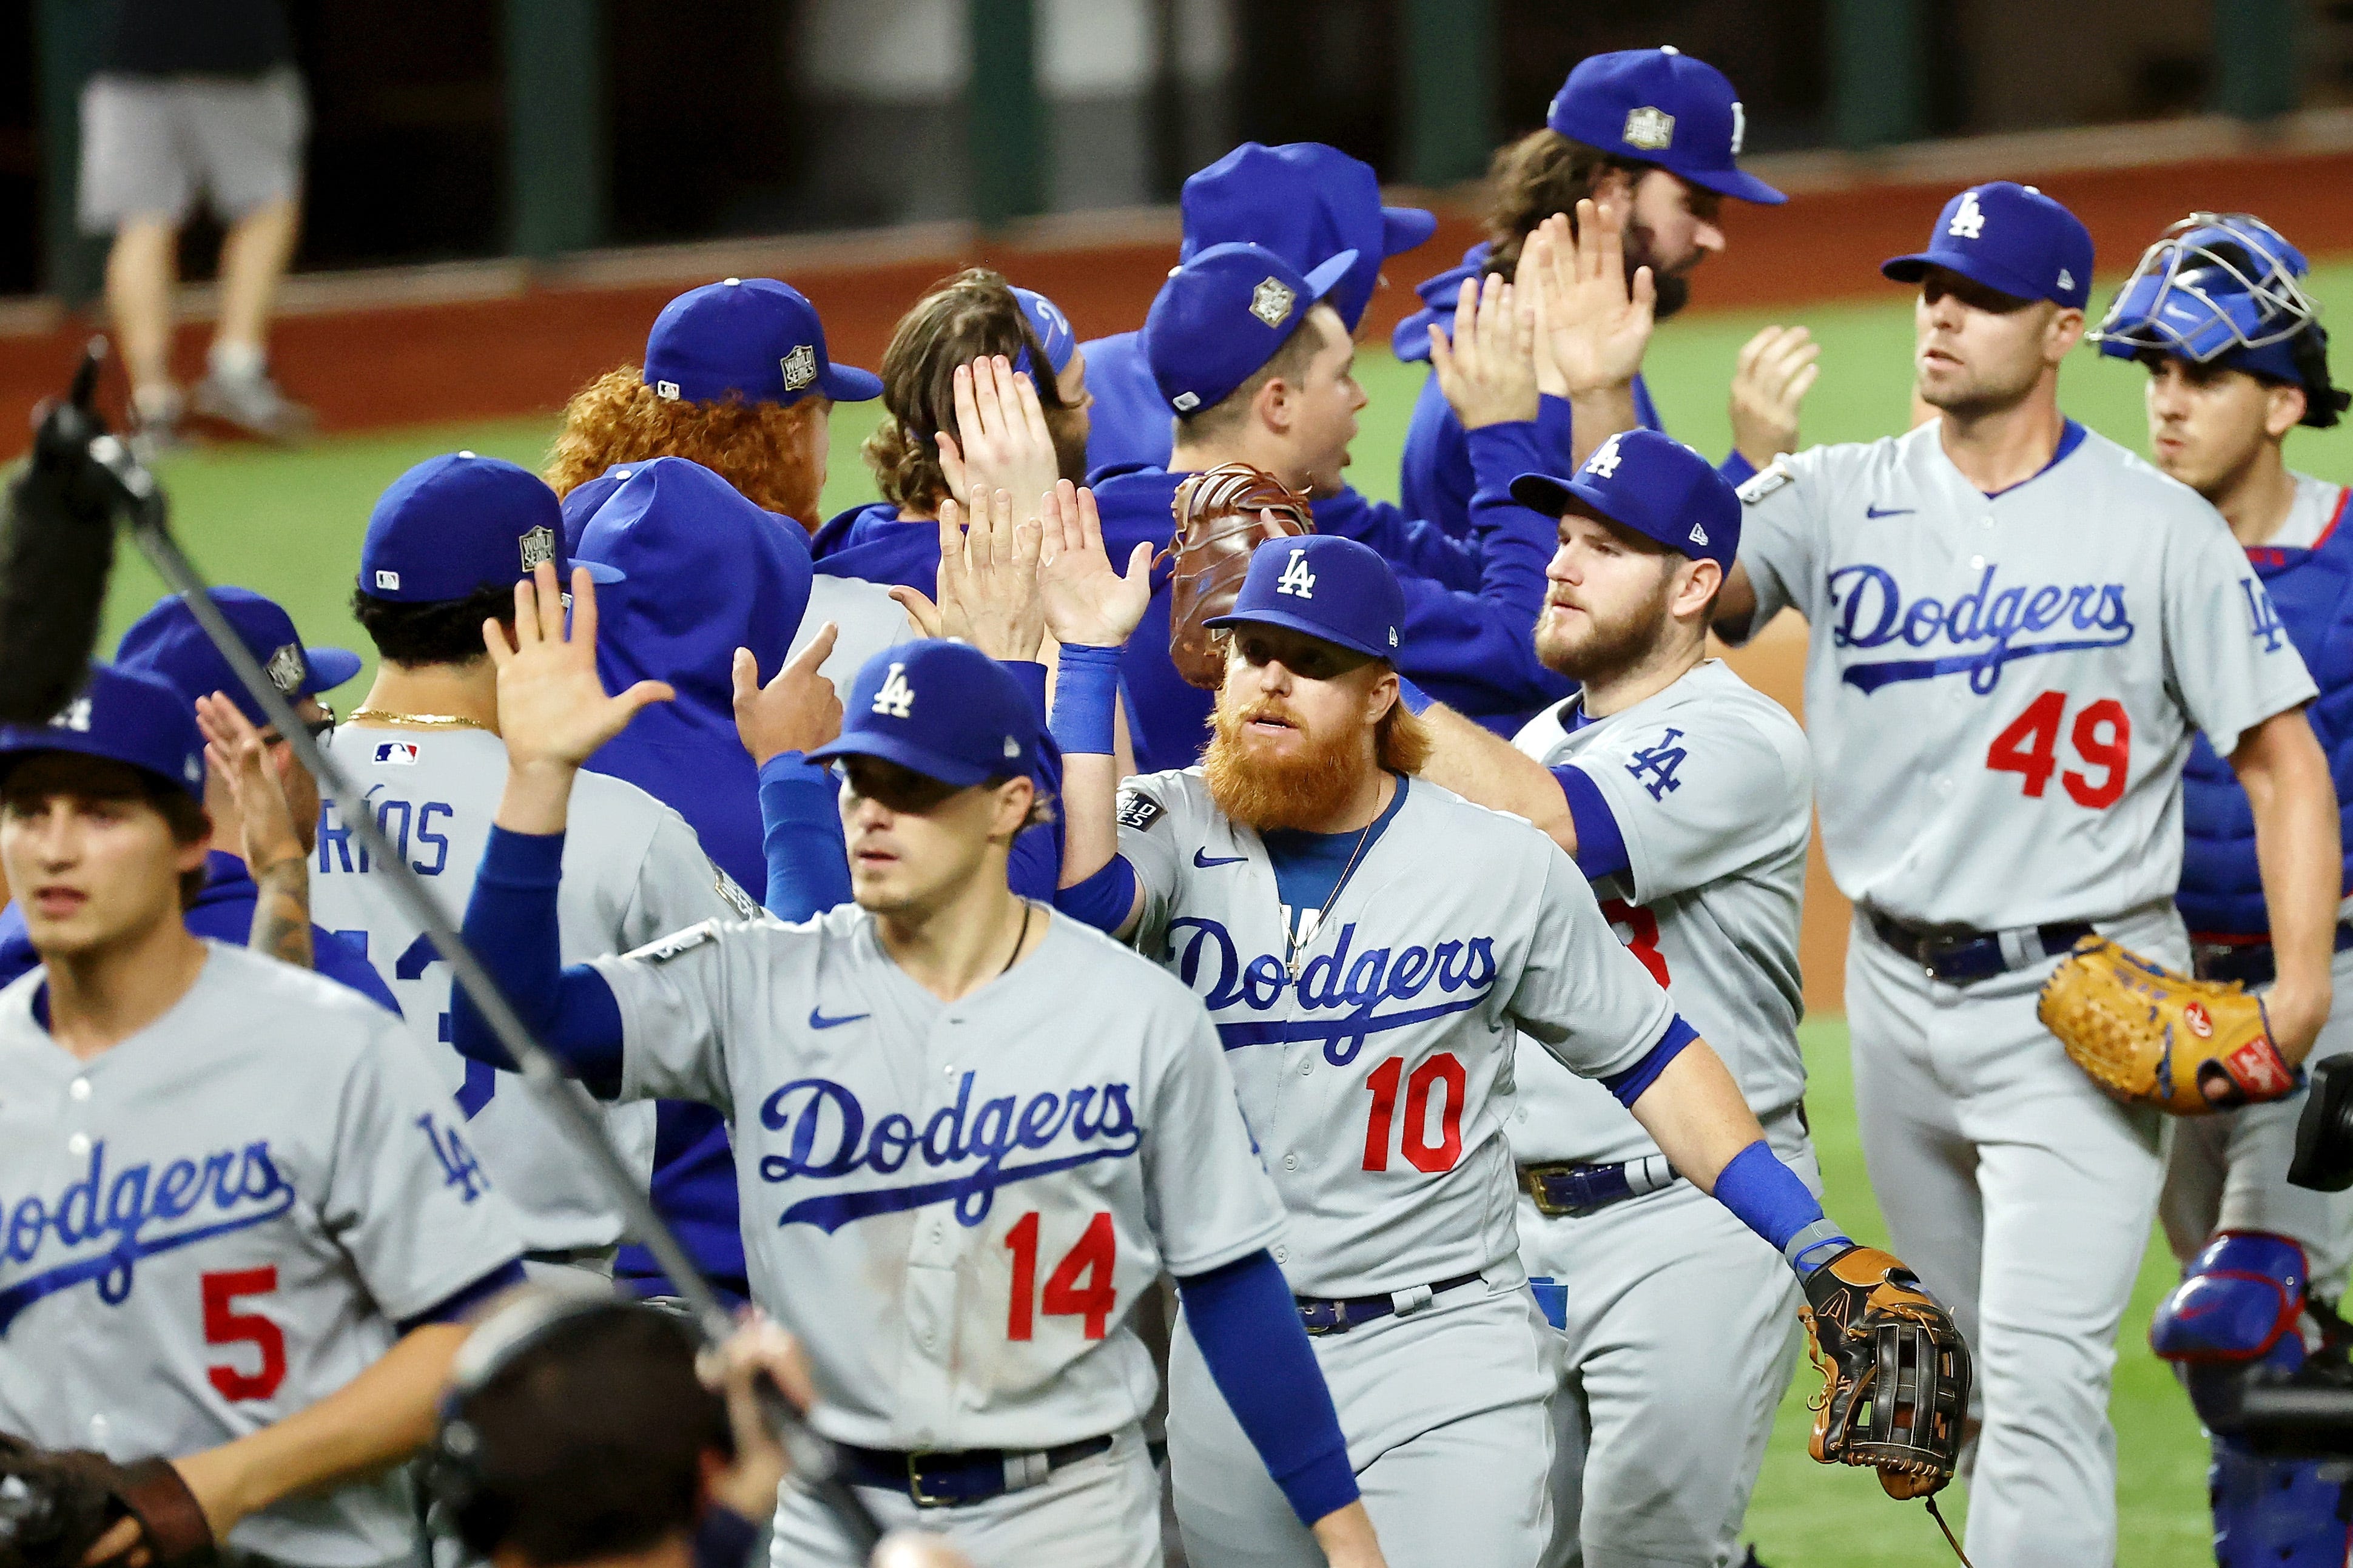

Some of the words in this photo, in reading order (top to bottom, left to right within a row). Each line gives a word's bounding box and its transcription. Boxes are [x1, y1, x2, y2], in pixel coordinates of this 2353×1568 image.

[1948, 191, 1985, 239] LA
[1585, 432, 1623, 479] LA
[1276, 548, 1316, 599] LA
[1827, 564, 2134, 695] Dodgers
[872, 662, 915, 719] LA
[1985, 690, 2132, 810] 49
[1624, 727, 1686, 803] LA
[1165, 916, 1497, 1066] Dodgers
[759, 1070, 1141, 1229] Dodgers
[1361, 1052, 1467, 1173] 10
[0, 1137, 295, 1305] odgers
[1004, 1210, 1117, 1342] 14
[200, 1264, 288, 1404] 5
